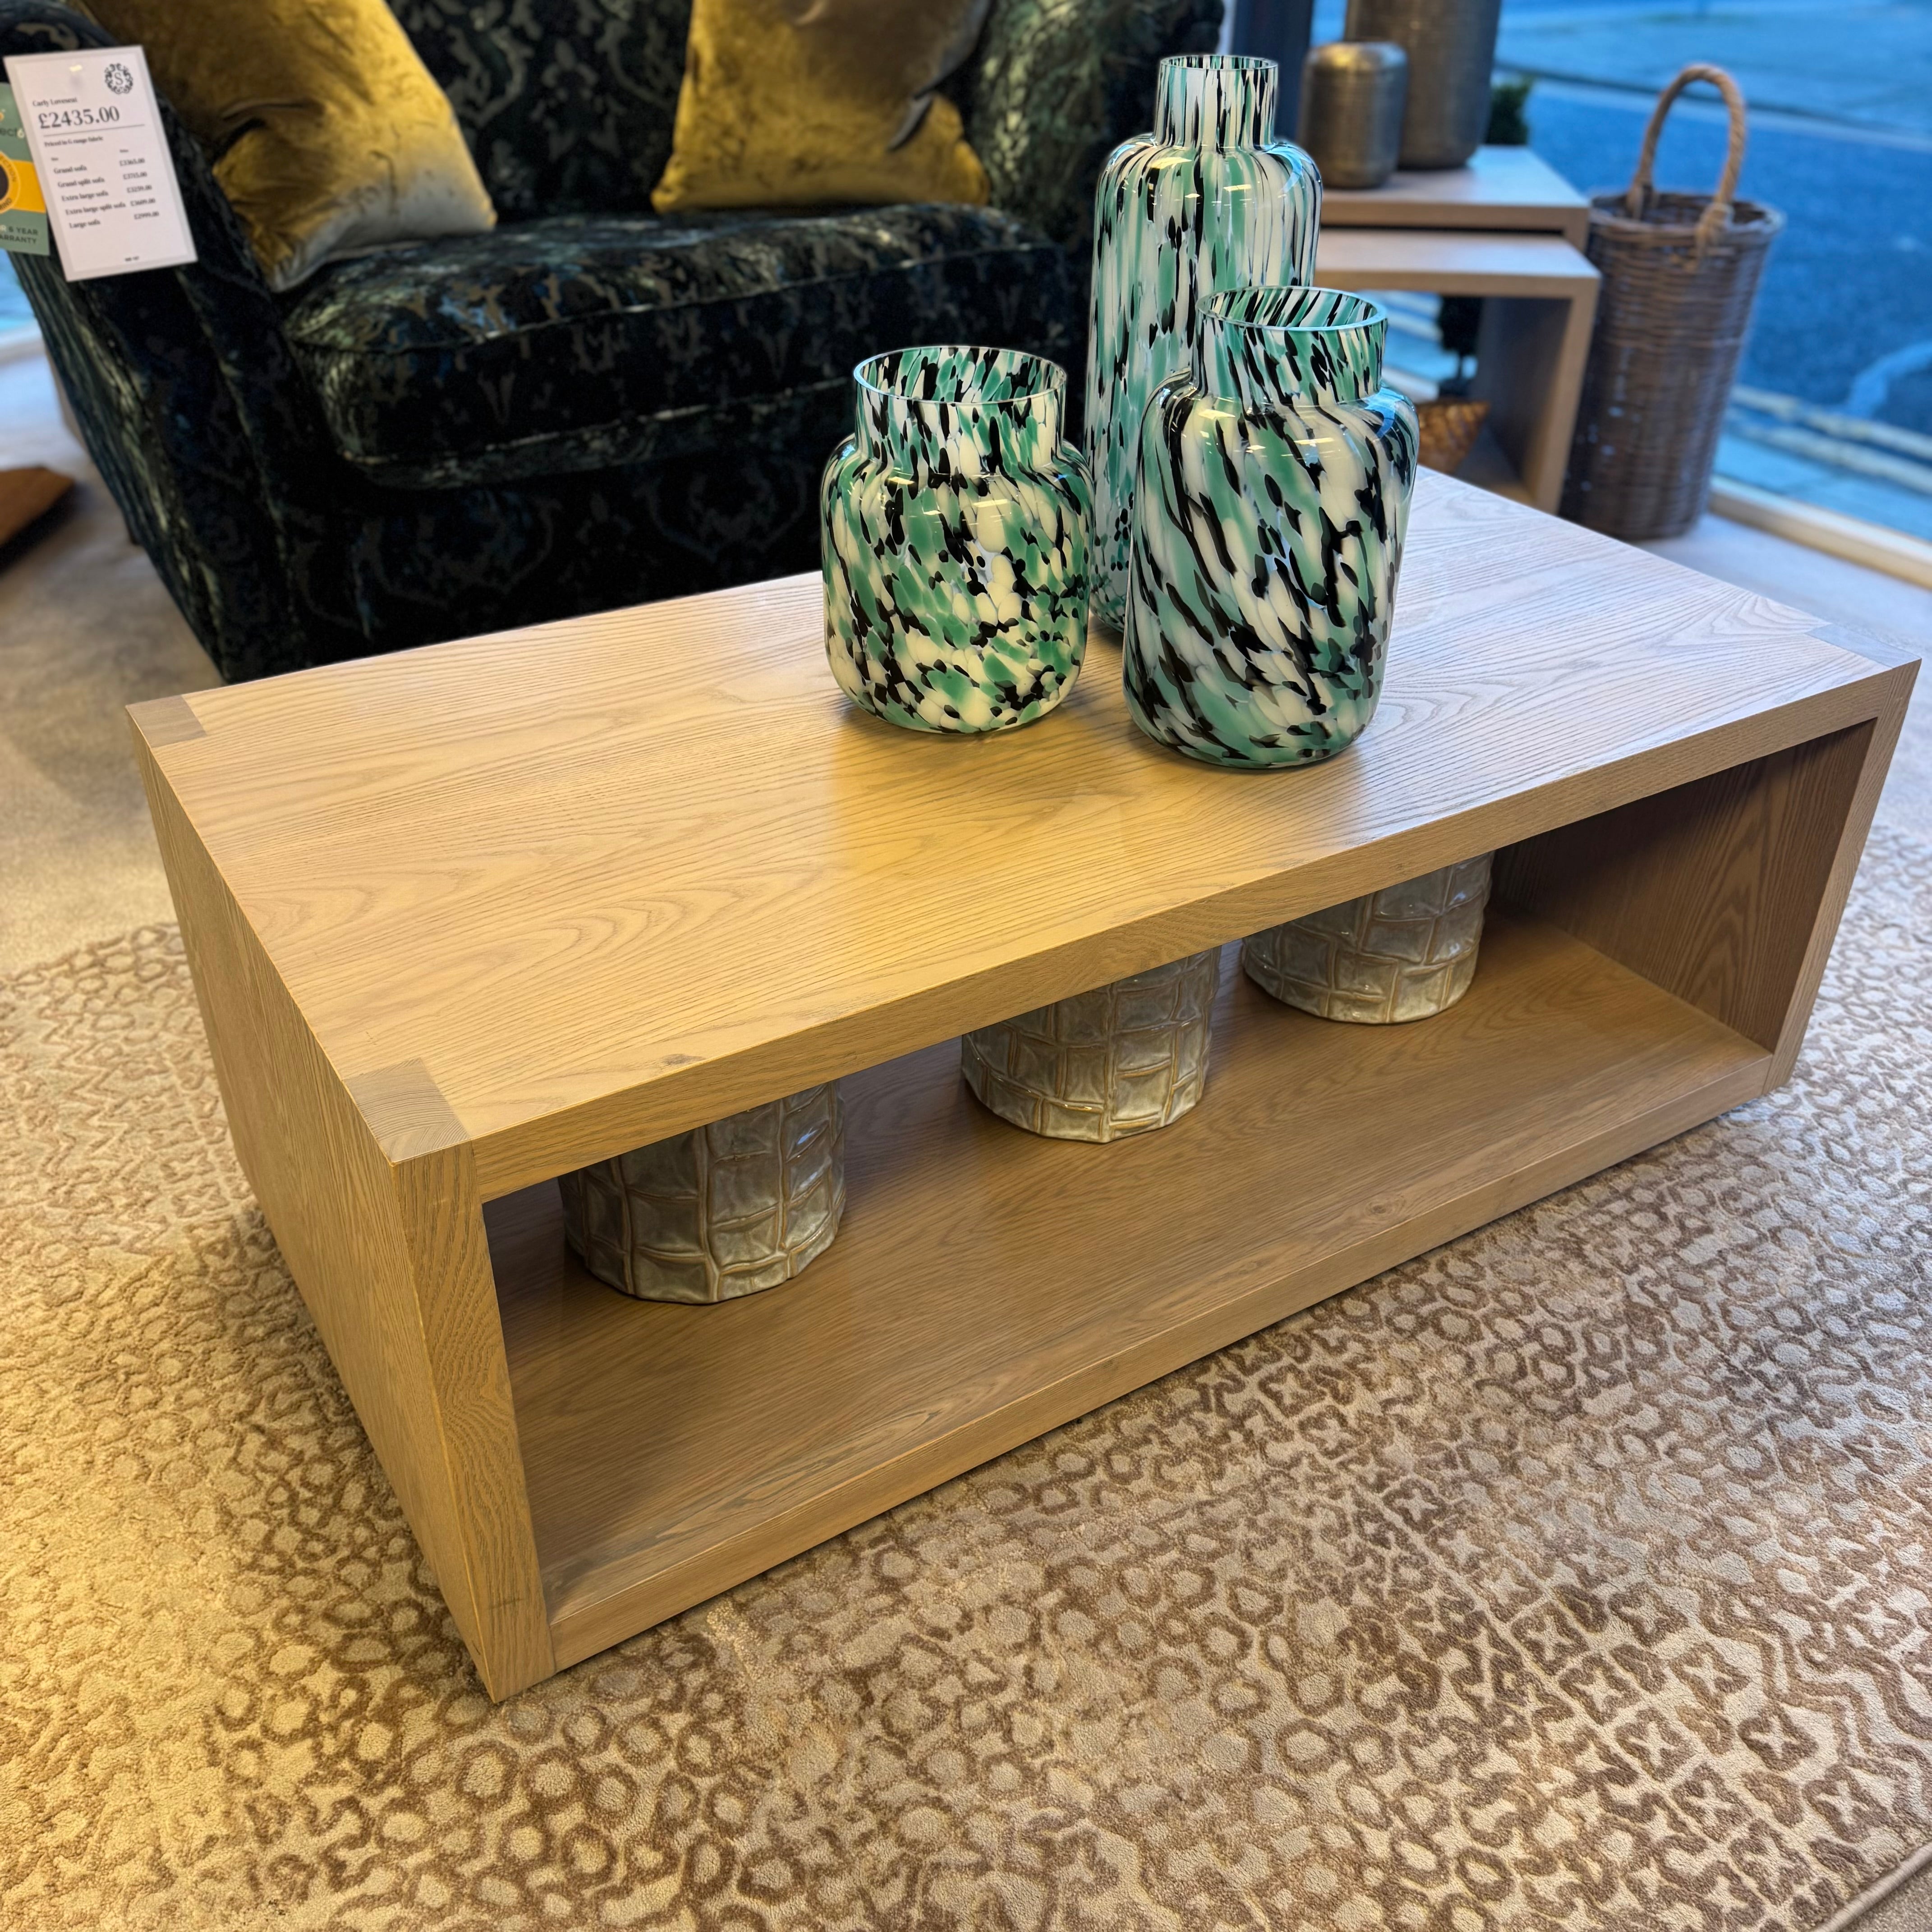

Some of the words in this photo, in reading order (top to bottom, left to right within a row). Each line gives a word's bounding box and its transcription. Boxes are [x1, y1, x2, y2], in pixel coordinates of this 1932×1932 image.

[38, 106, 120, 129] £2435.00
[78, 178, 91, 187] split
[99, 203, 112, 212] split
[16, 227, 38, 235] YEAR
[0, 234, 37, 244] ARRANTY
